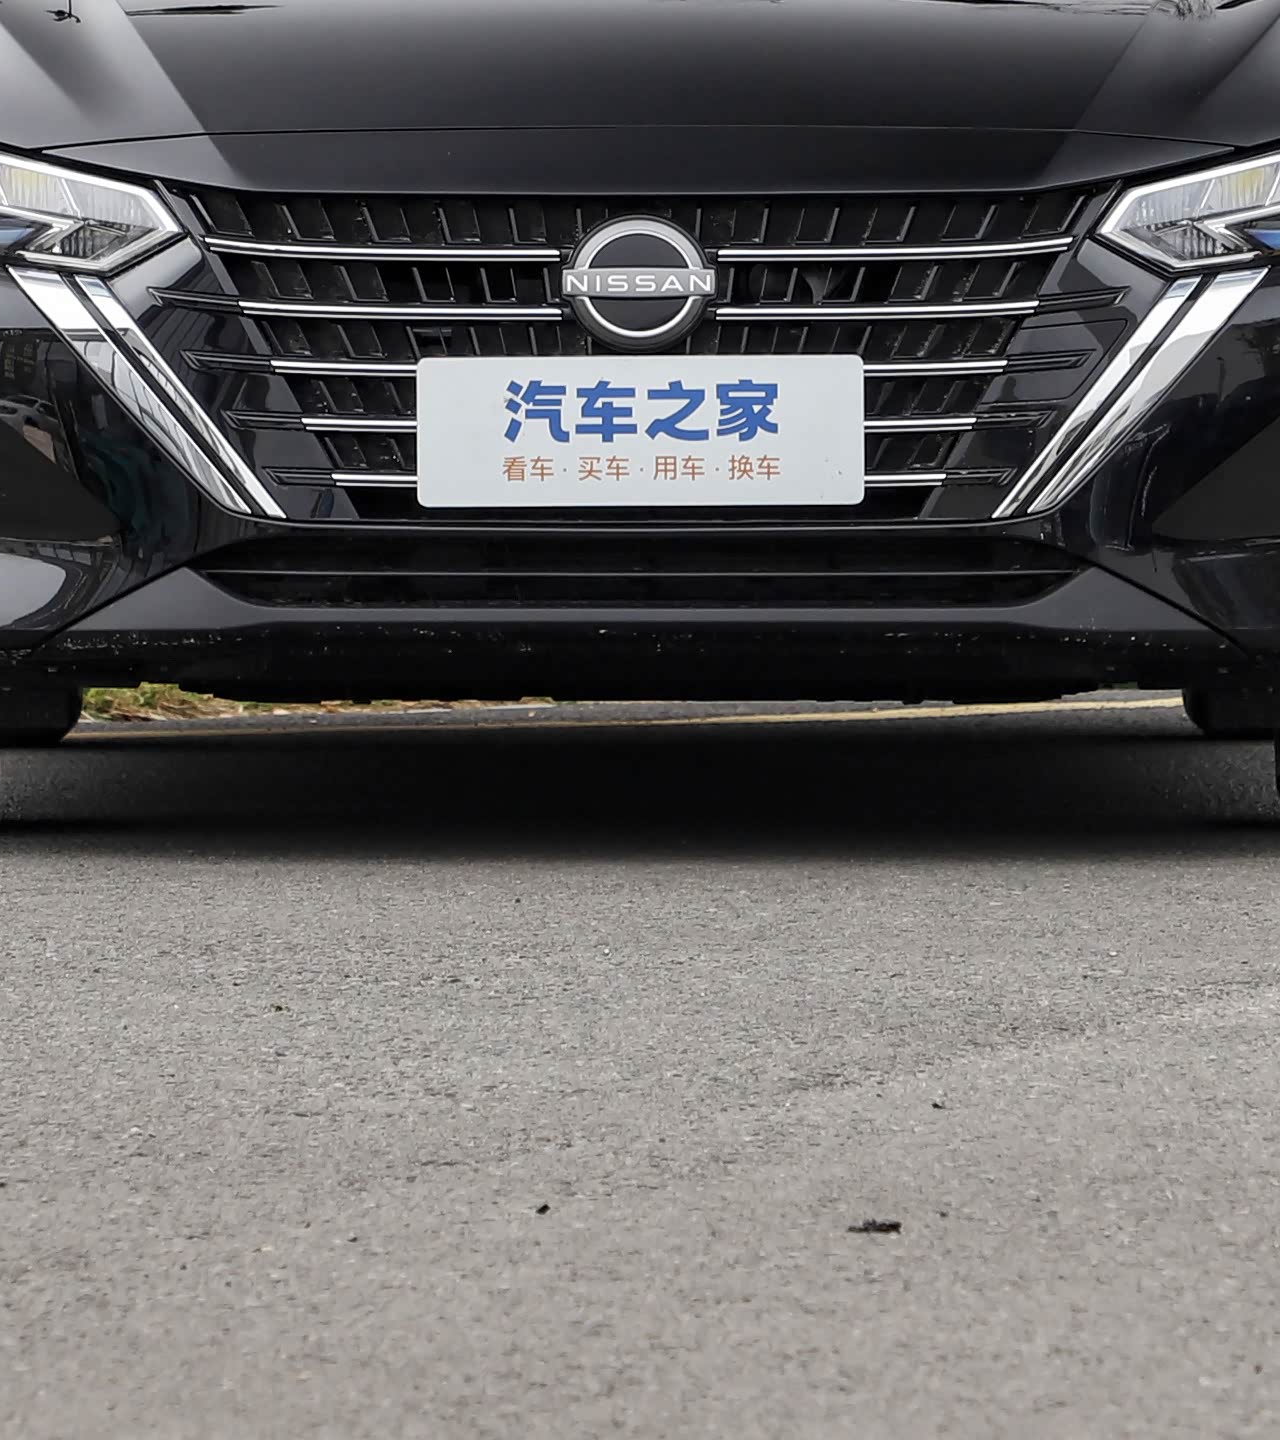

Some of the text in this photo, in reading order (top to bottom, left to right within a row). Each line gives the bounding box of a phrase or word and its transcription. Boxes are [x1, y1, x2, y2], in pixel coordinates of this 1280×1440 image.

[567, 274, 713, 293] NISSAN
[504, 379, 778, 443] 汽车之家
